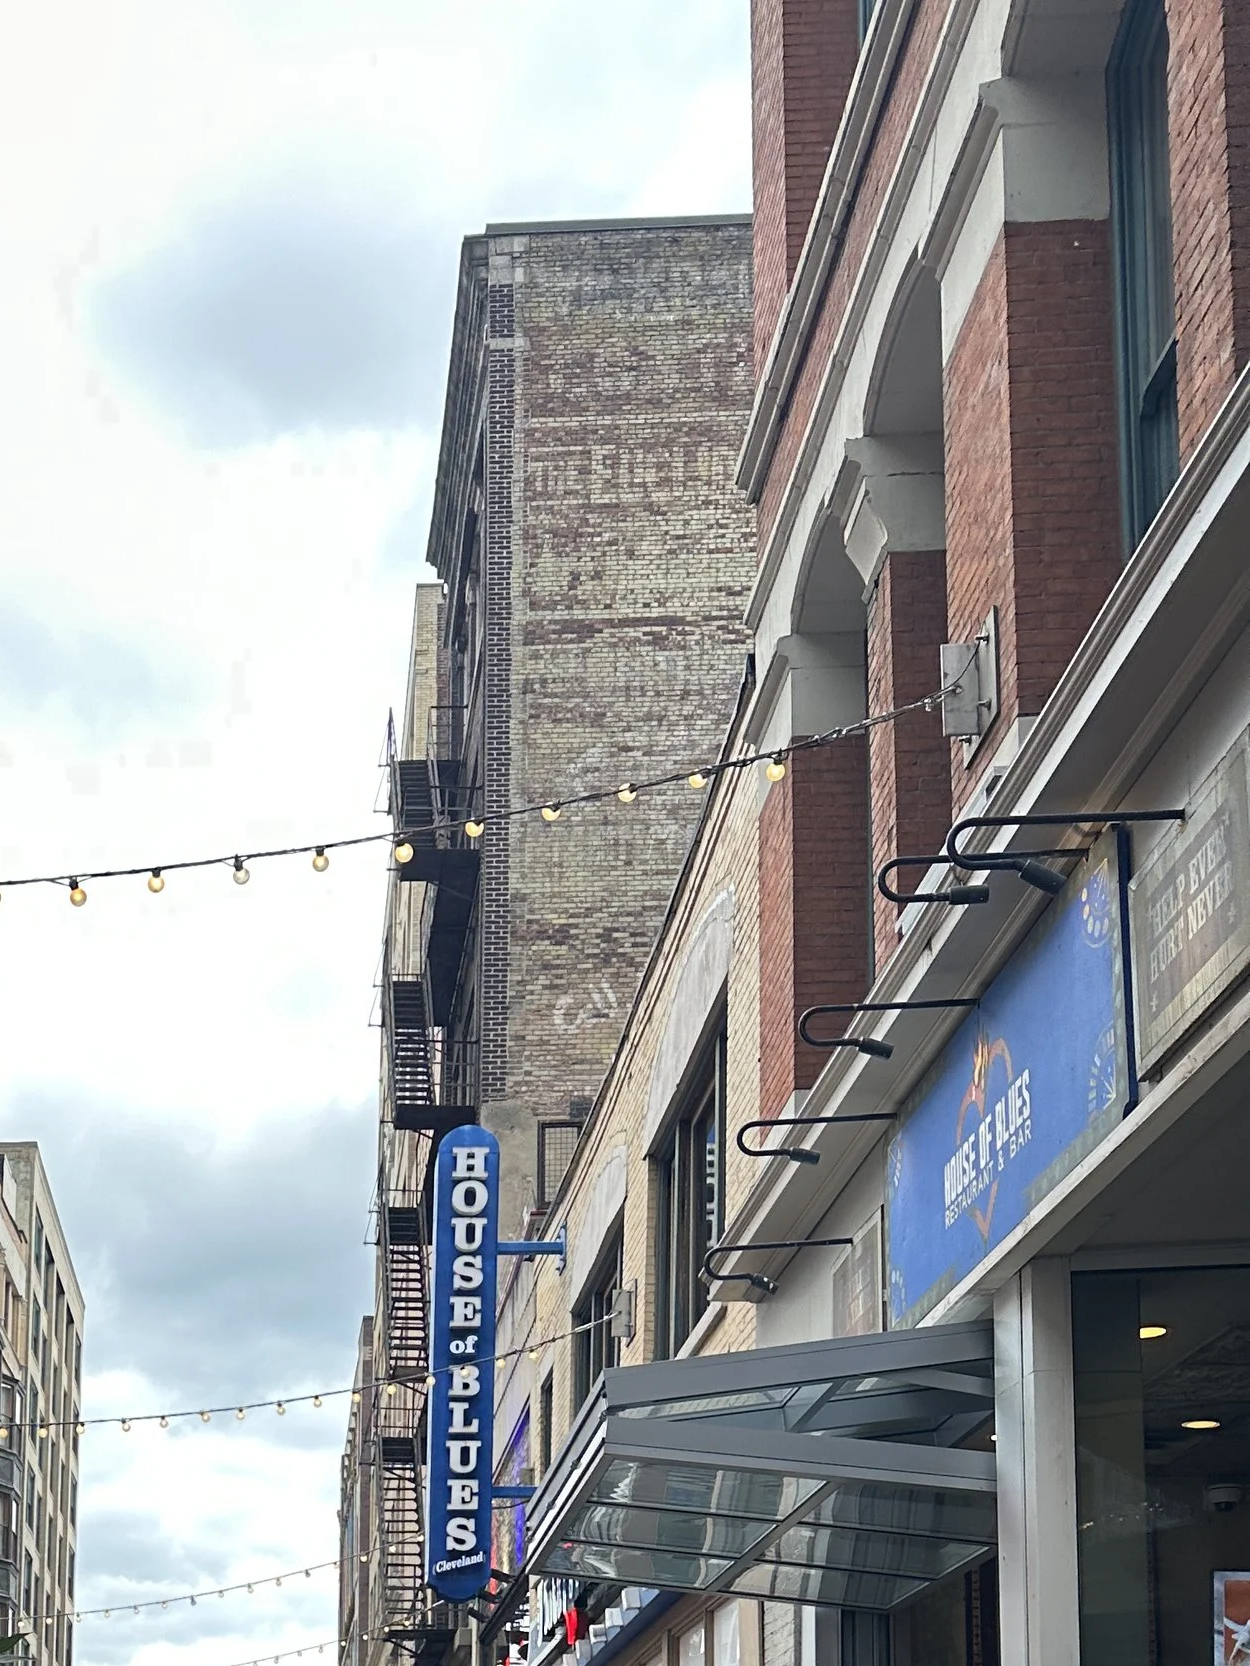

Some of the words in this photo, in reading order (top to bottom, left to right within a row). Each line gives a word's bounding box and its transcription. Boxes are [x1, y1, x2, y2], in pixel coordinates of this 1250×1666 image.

[1150, 915, 1185, 985] HURT
[944, 1133, 977, 1209] HOUSE
[979, 1113, 992, 1170] OF
[995, 1068, 1031, 1152] BLUES
[944, 1160, 994, 1231] RESTAURANT
[997, 1149, 1005, 1172] &
[1010, 1118, 1032, 1160] BAR
[449, 1146, 490, 1330] HOUSE
[449, 1335, 478, 1354] of
[446, 1364, 482, 1552] BLUES
